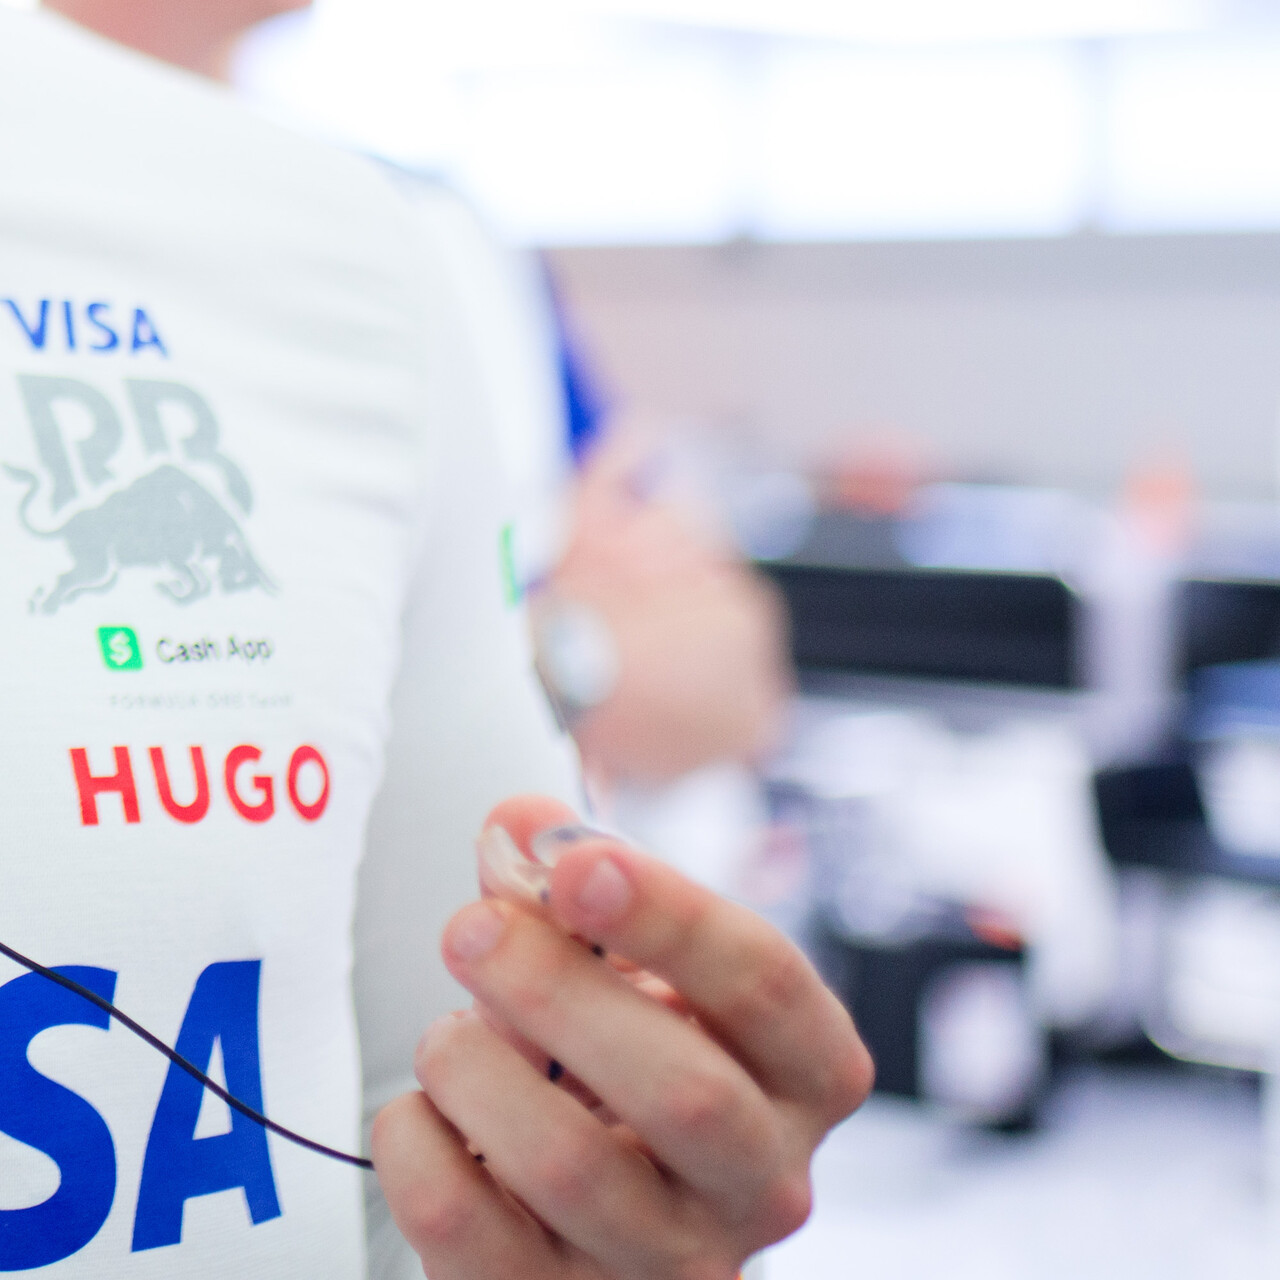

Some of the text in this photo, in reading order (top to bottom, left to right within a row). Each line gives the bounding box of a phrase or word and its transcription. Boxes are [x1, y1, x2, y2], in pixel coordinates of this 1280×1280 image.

[156, 637, 219, 663] Cash
[226, 634, 272, 664] App
[69, 744, 331, 826] HUGO
